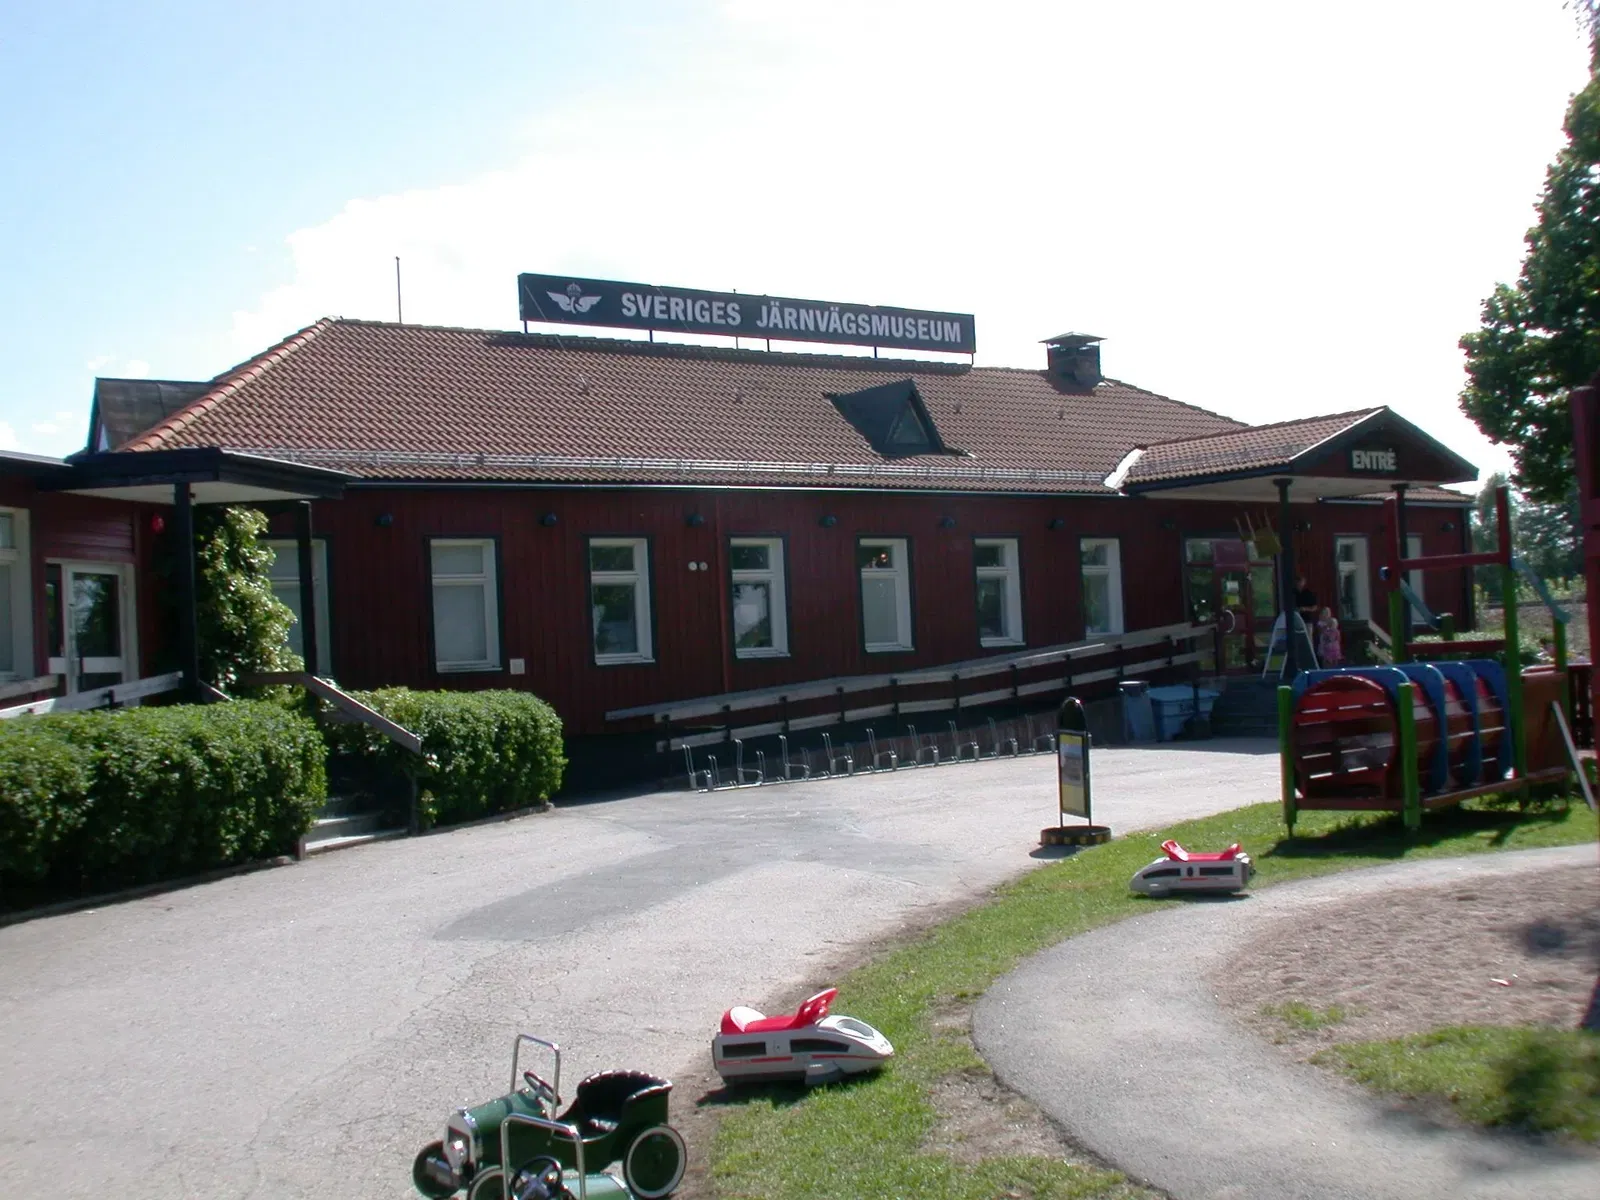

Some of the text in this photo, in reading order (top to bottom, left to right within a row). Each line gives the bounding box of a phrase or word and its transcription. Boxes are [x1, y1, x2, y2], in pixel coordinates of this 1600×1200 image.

[621, 292, 961, 343] SVERIGES JÄRNVÄGSMUSEUM
[1351, 447, 1397, 470] ENTRÉ
